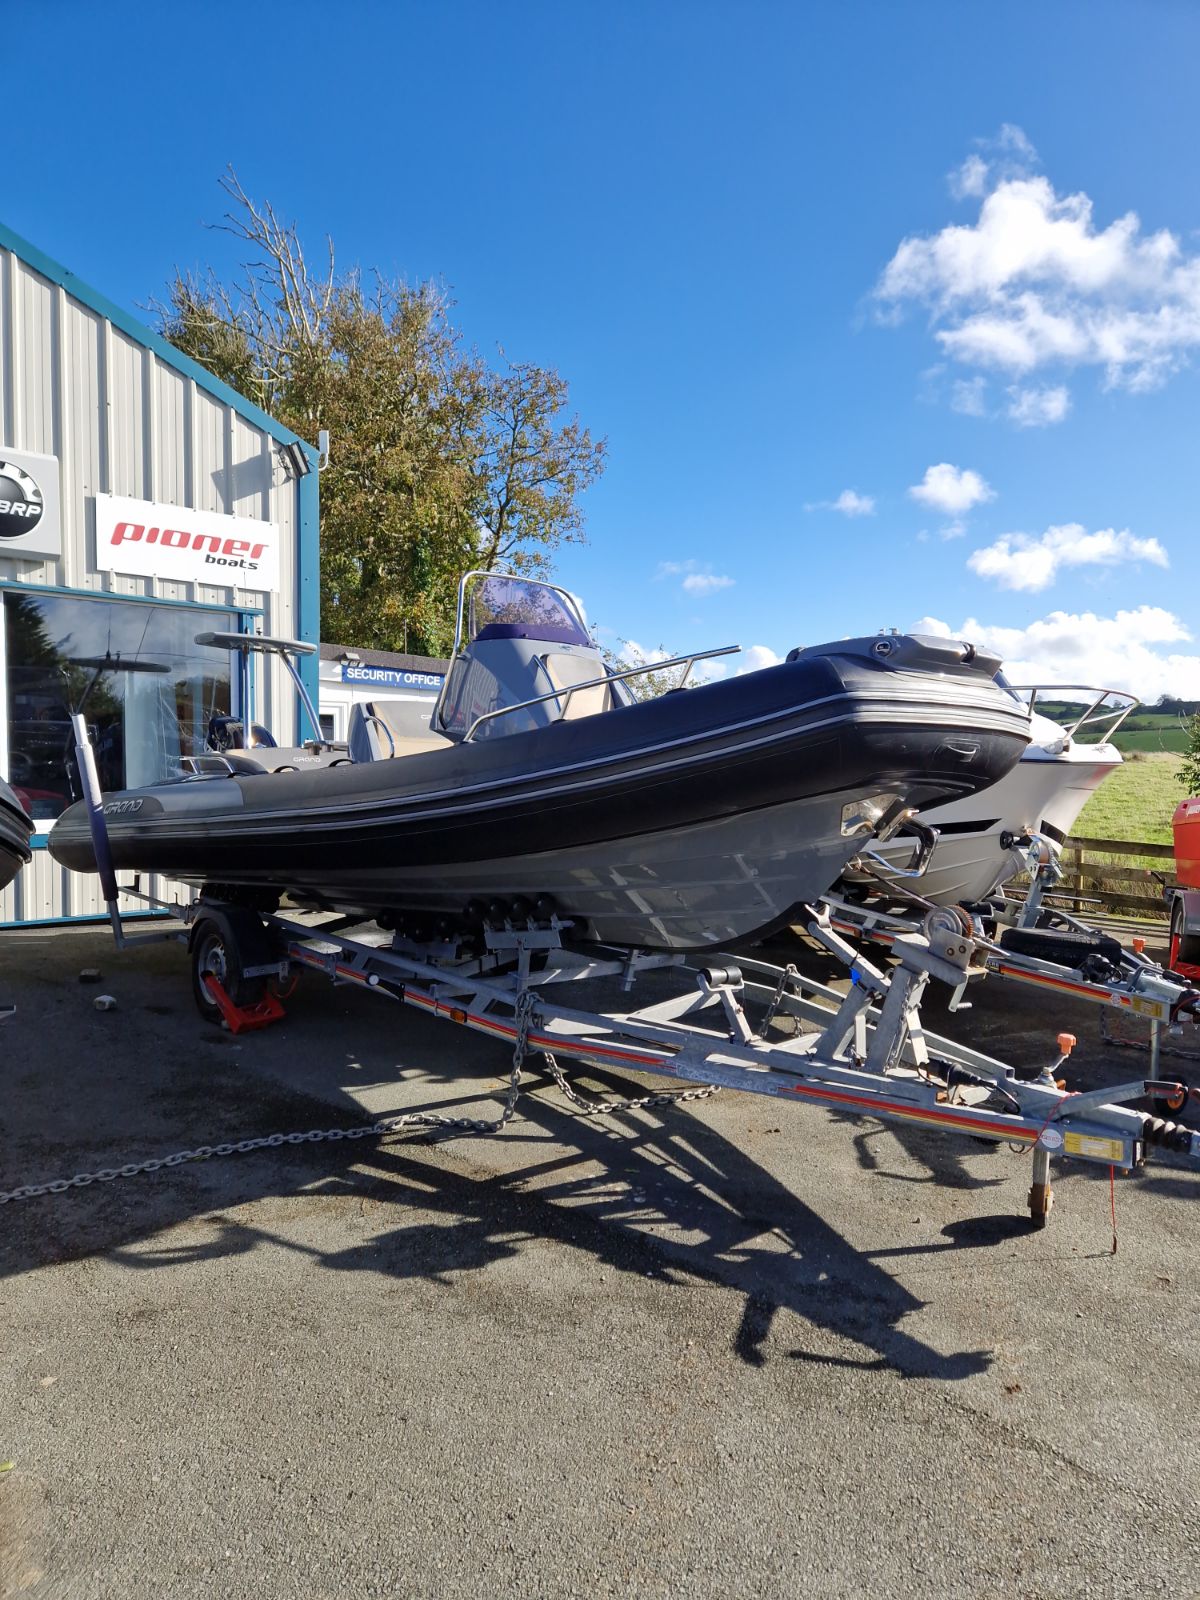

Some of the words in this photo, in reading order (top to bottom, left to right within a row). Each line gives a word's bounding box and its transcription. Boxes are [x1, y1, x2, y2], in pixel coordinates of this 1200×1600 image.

[110, 522, 269, 559] pioner
[205, 554, 258, 570] boats
[347, 668, 401, 682] SECURITY
[404, 673, 440, 685] OFFICE
